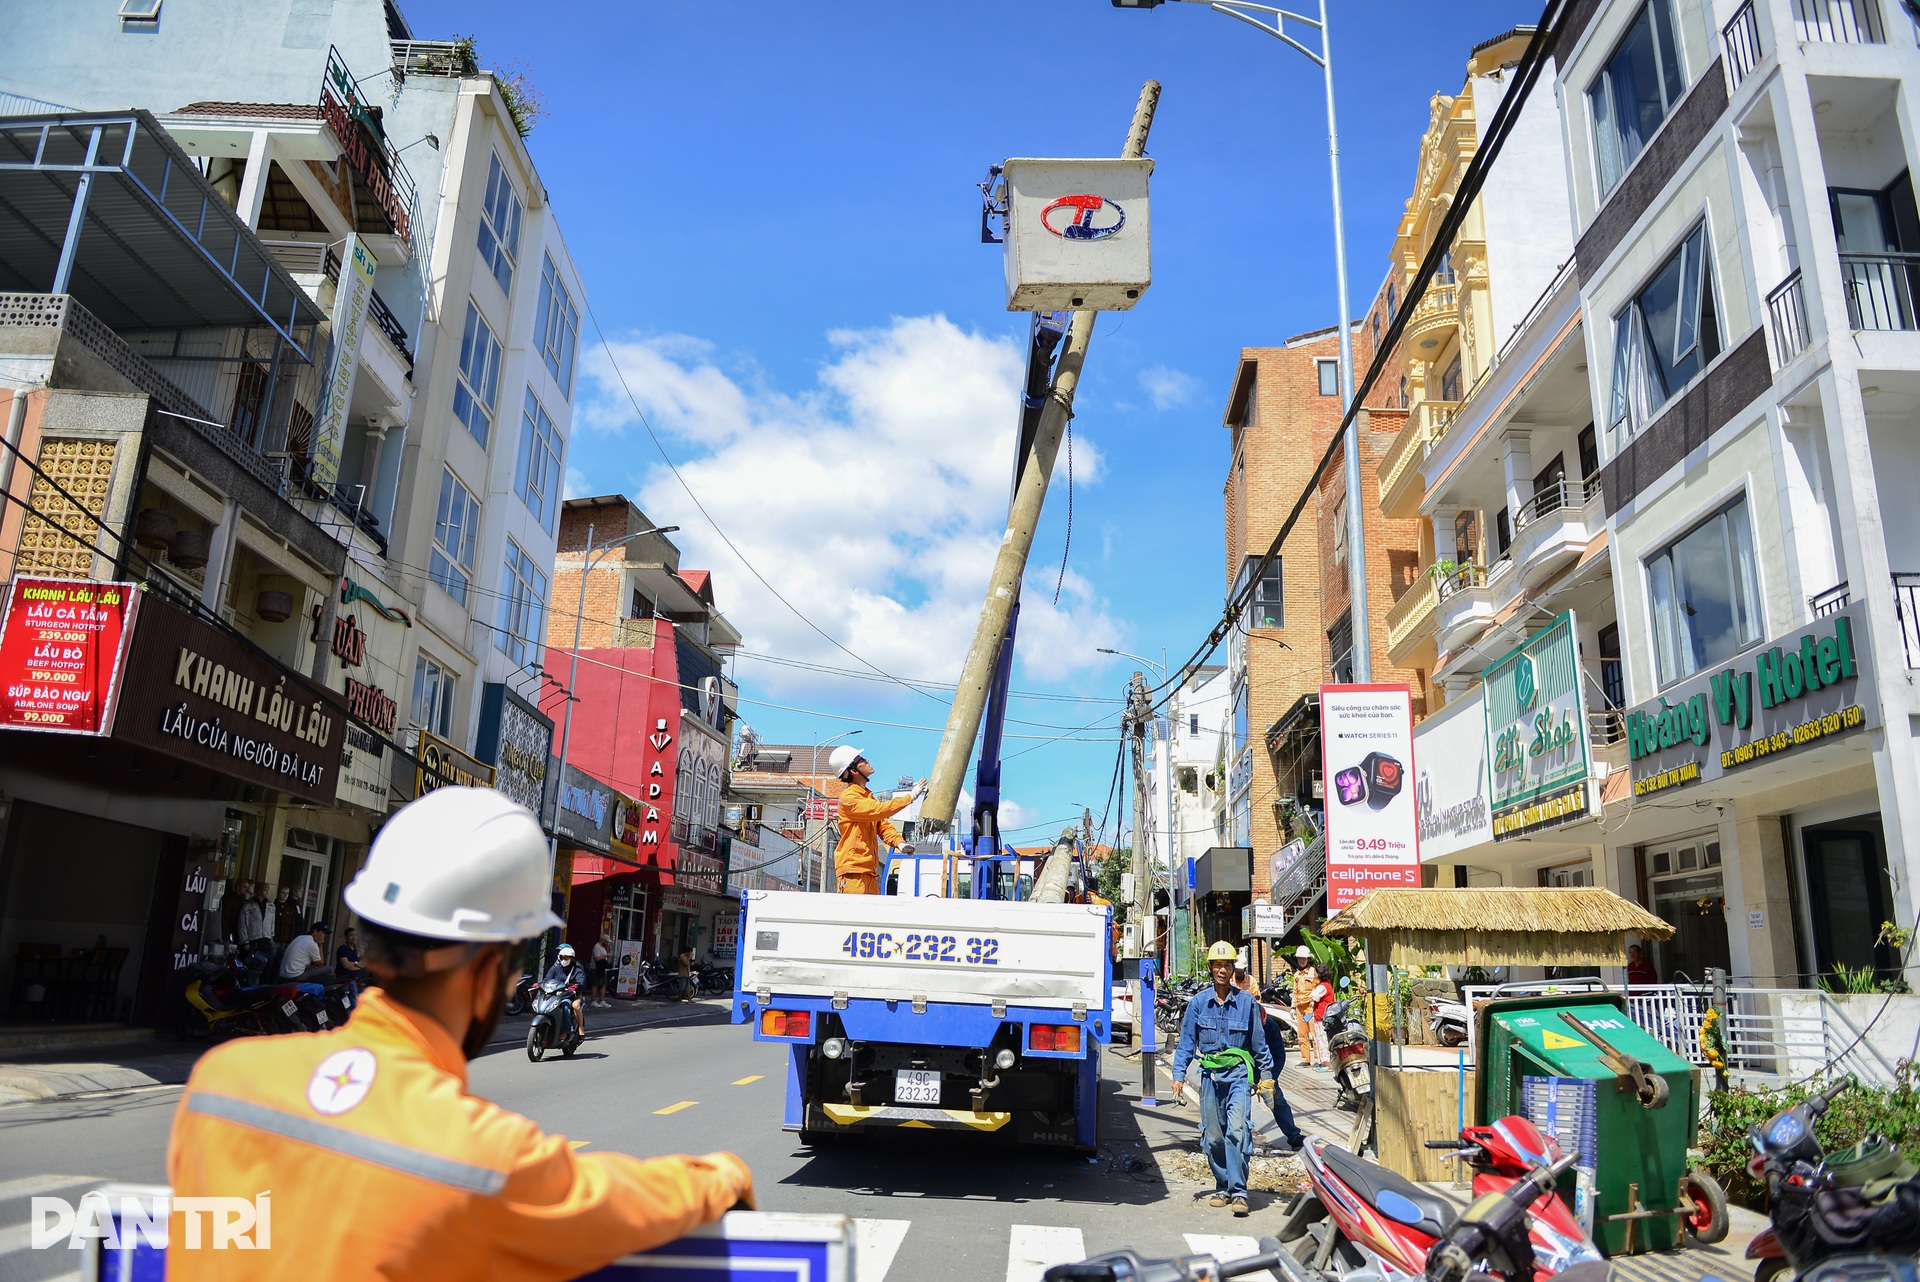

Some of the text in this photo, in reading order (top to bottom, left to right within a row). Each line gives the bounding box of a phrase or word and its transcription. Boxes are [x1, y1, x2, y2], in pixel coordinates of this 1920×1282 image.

[23, 588, 66, 600] KHANH
[56, 607, 76, 620] CÁ
[25, 620, 106, 632] STURGEON HOTPOT
[39, 630, 87, 642] 239.000
[62, 647, 83, 660] BÒ
[27, 659, 85, 670] BEEF HOTPOT
[31, 671, 76, 682] 199.000
[8, 684, 31, 697] SÚP
[33, 686, 60, 700] BÀO
[1627, 615, 1858, 760] Hoàng Vy Hotel
[175, 647, 331, 748] KHANH LẨU LẤU
[14, 700, 80, 711] ABALONE SOUP
[23, 712, 65, 723] 99.000
[162, 702, 195, 740] LẨU
[197, 717, 228, 752] CỦA
[232, 735, 278, 770] NGƯỜI
[280, 753, 298, 777] ĐÀ
[301, 761, 324, 787] LẠT
[1494, 705, 1577, 783] Elly Shop
[1721, 751, 1734, 769] ĐT:
[1734, 745, 1755, 766] 0903
[1755, 738, 1770, 758] 754
[1771, 732, 1787, 753] 343
[1793, 723, 1822, 745] 02633
[1822, 714, 1840, 735] 520
[1840, 705, 1861, 727] 150
[1645, 777, 1657, 793] 132
[642, 760, 661, 846] ADAM
[1356, 837, 1406, 850] 9.49 Triệu
[185, 866, 207, 894] LẨU
[1337, 887, 1353, 895] 279
[181, 910, 198, 932] CÁ
[842, 931, 999, 965] 49C 232.32
[907, 1071, 930, 1086] 49C
[897, 1087, 938, 1102] 232.32
